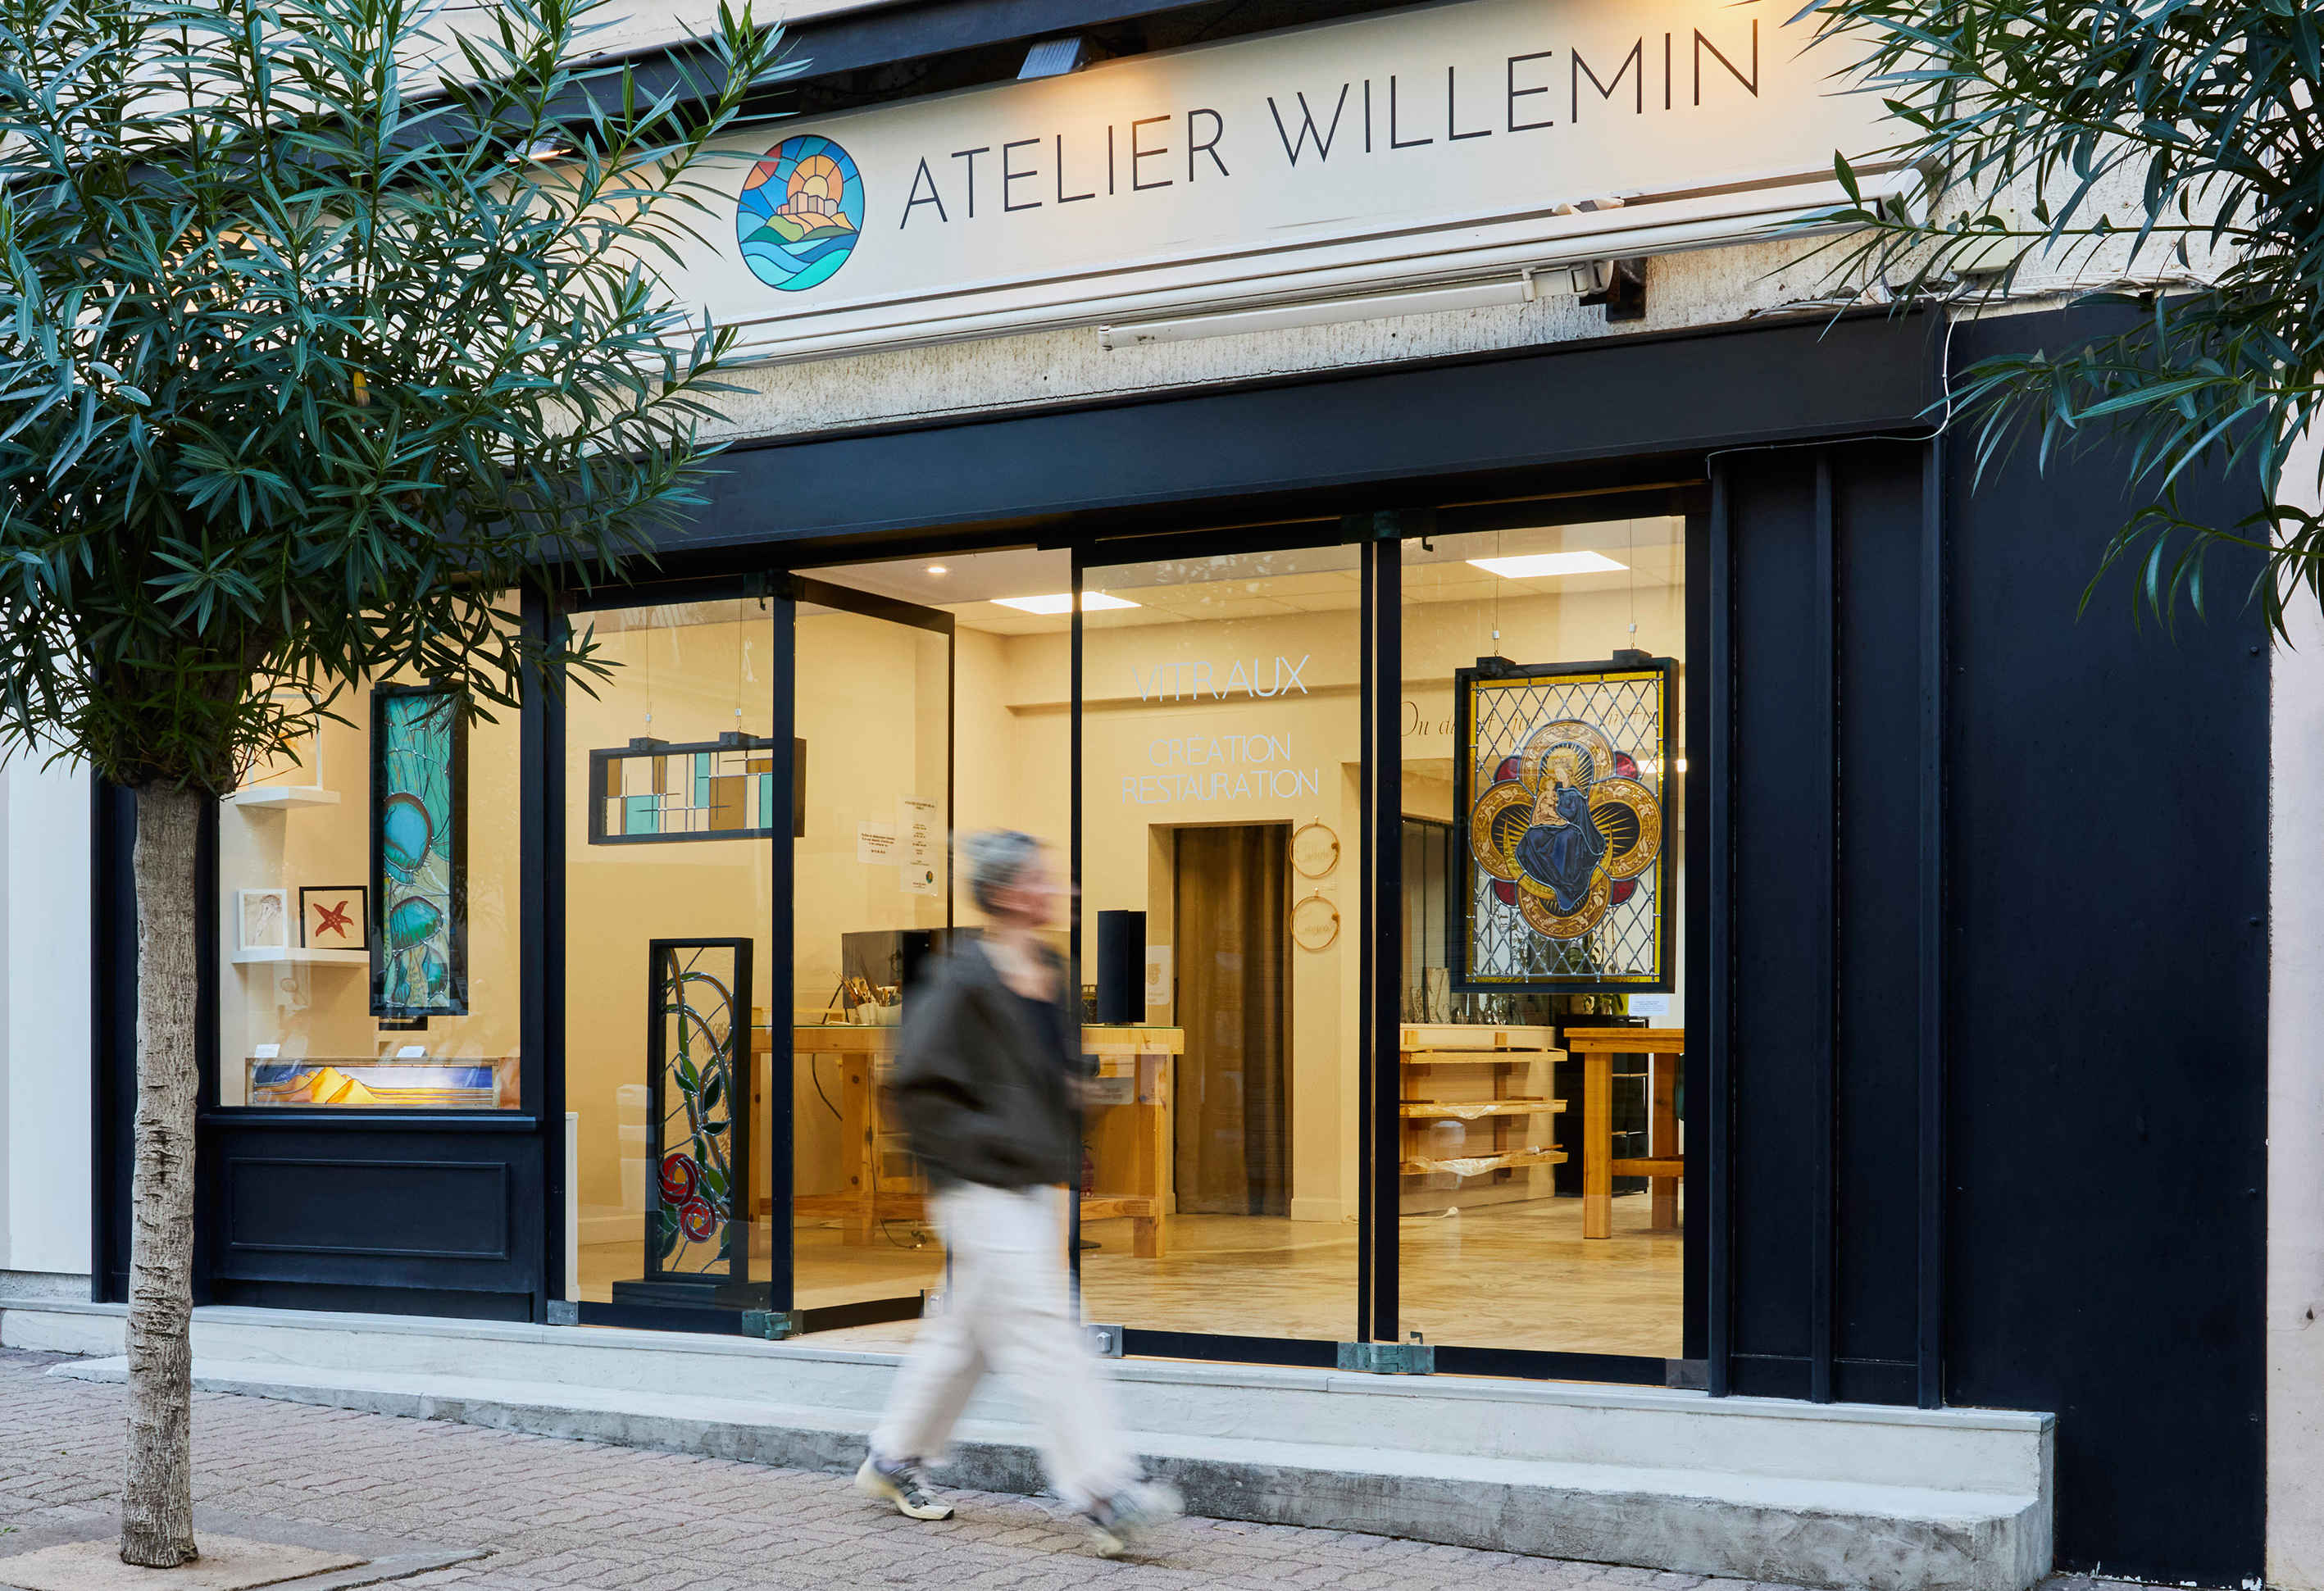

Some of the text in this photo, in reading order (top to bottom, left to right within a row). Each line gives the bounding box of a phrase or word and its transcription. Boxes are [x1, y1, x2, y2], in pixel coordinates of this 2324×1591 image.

[900, 18, 1760, 230] ATELIER WILLEMIN
[1131, 654, 1309, 702] VITRAUX
[1148, 733, 1291, 767] CRÉATION
[1122, 768, 1319, 804] RESTAURATION
